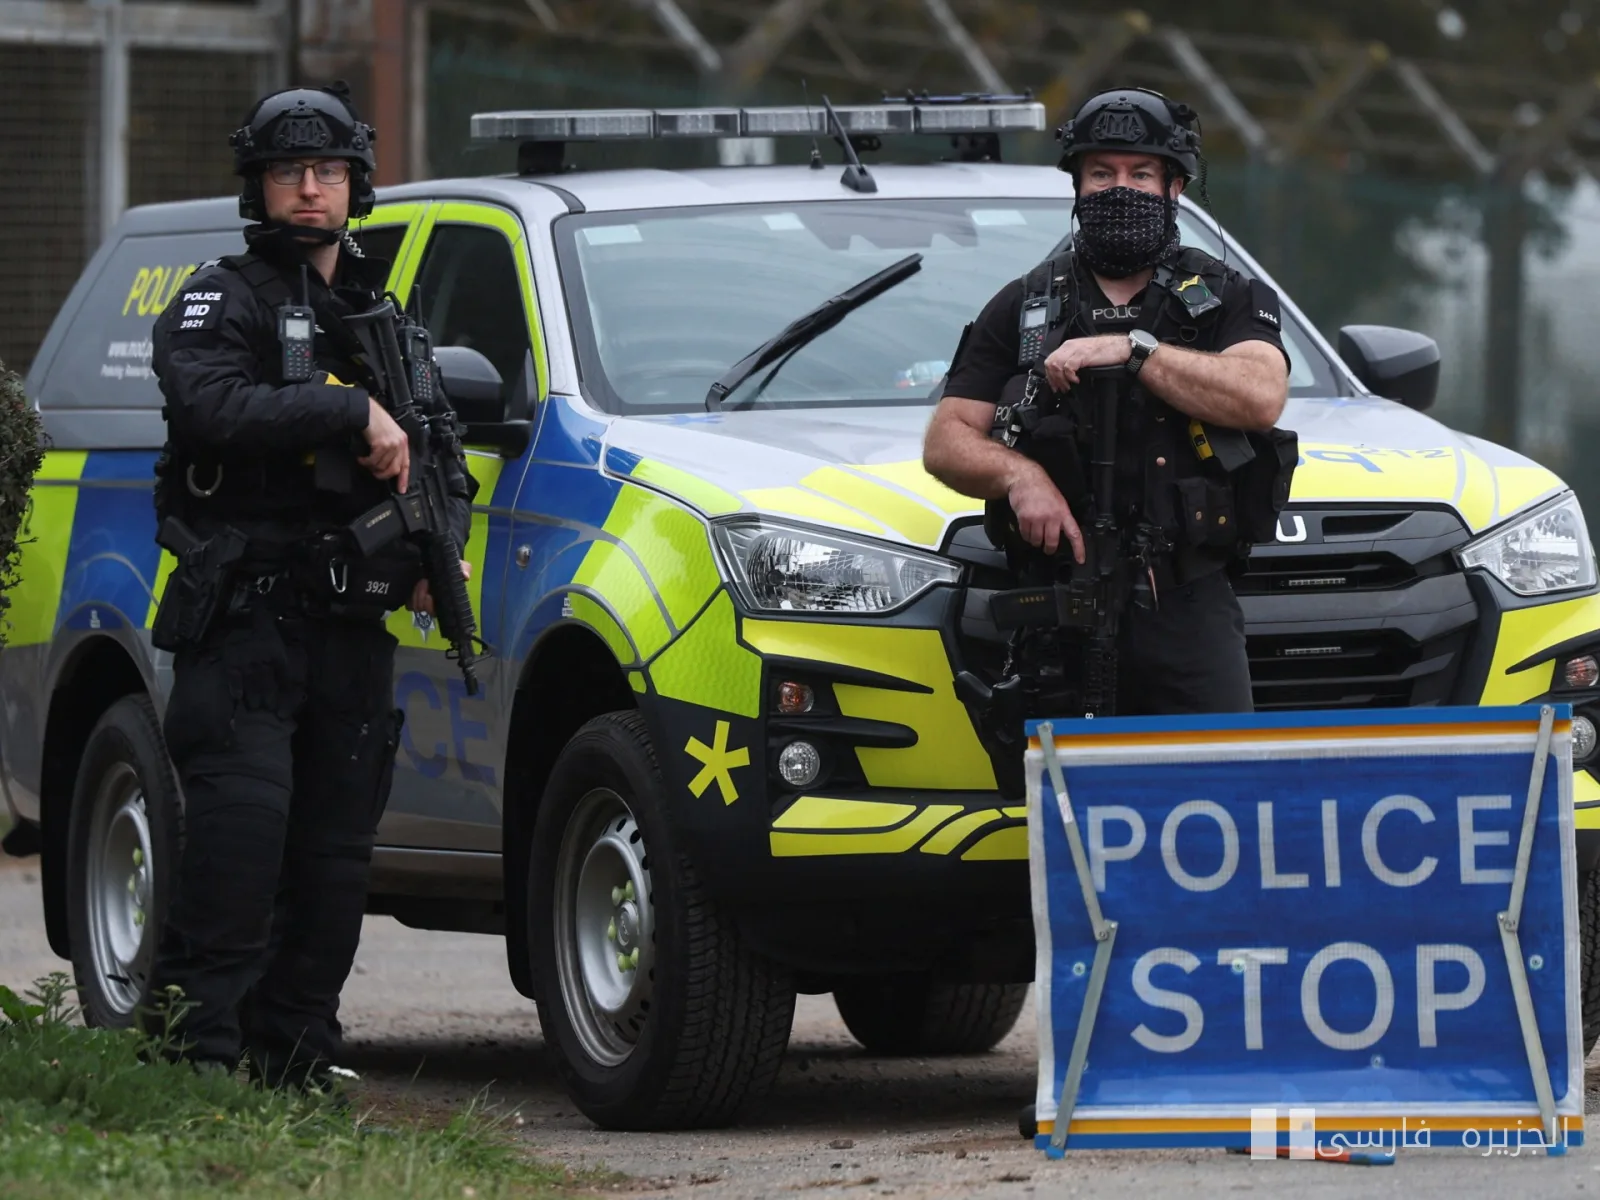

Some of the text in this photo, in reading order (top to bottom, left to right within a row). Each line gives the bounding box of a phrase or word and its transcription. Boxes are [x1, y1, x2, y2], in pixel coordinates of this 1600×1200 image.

[183, 292, 223, 302] POLICE
[184, 304, 210, 317] MD
[1092, 306, 1141, 320] POLIC
[180, 319, 204, 329] 3921
[365, 580, 390, 594] 3921
[1087, 795, 1513, 892] POLICE
[1130, 941, 1486, 1053] STOP
